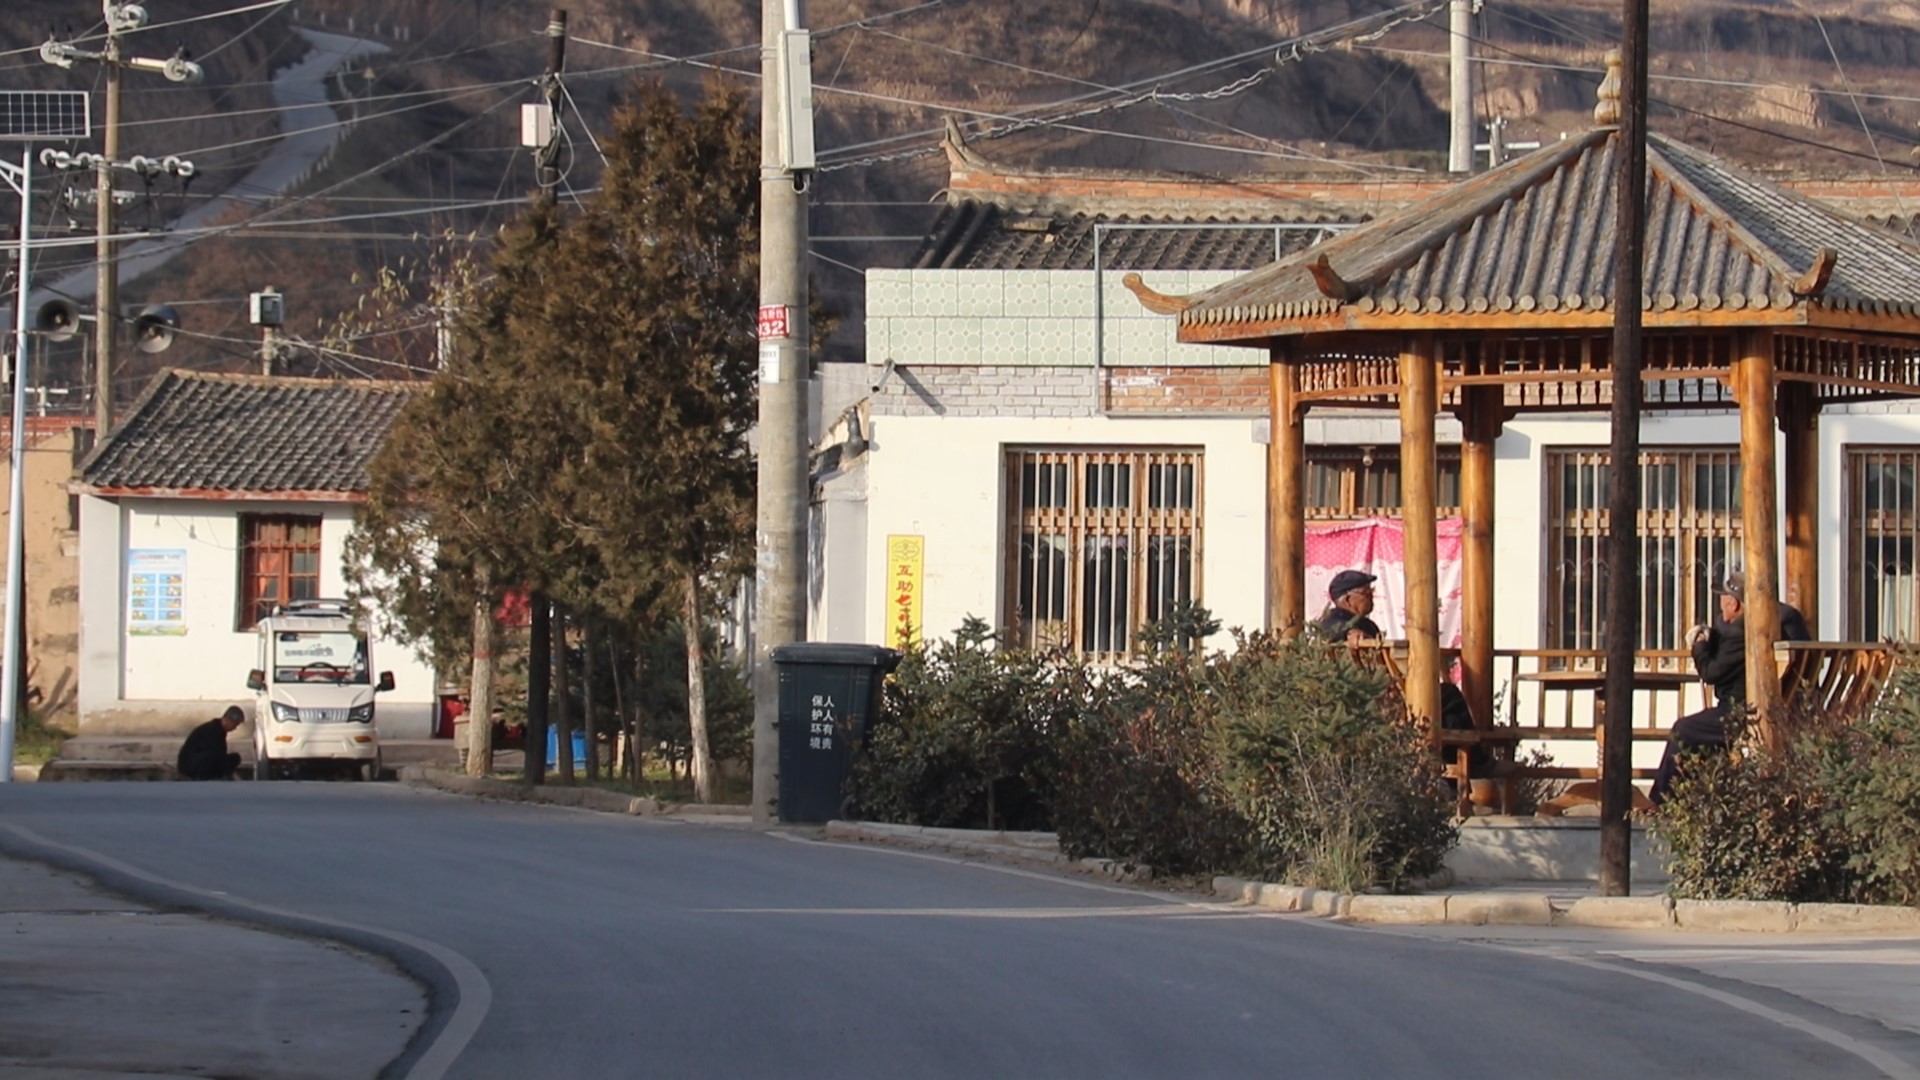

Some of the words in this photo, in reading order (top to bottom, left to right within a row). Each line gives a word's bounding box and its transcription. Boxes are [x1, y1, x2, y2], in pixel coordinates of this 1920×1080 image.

[810, 694, 823, 749] 保护环境
[822, 695, 834, 749] 人人有责
